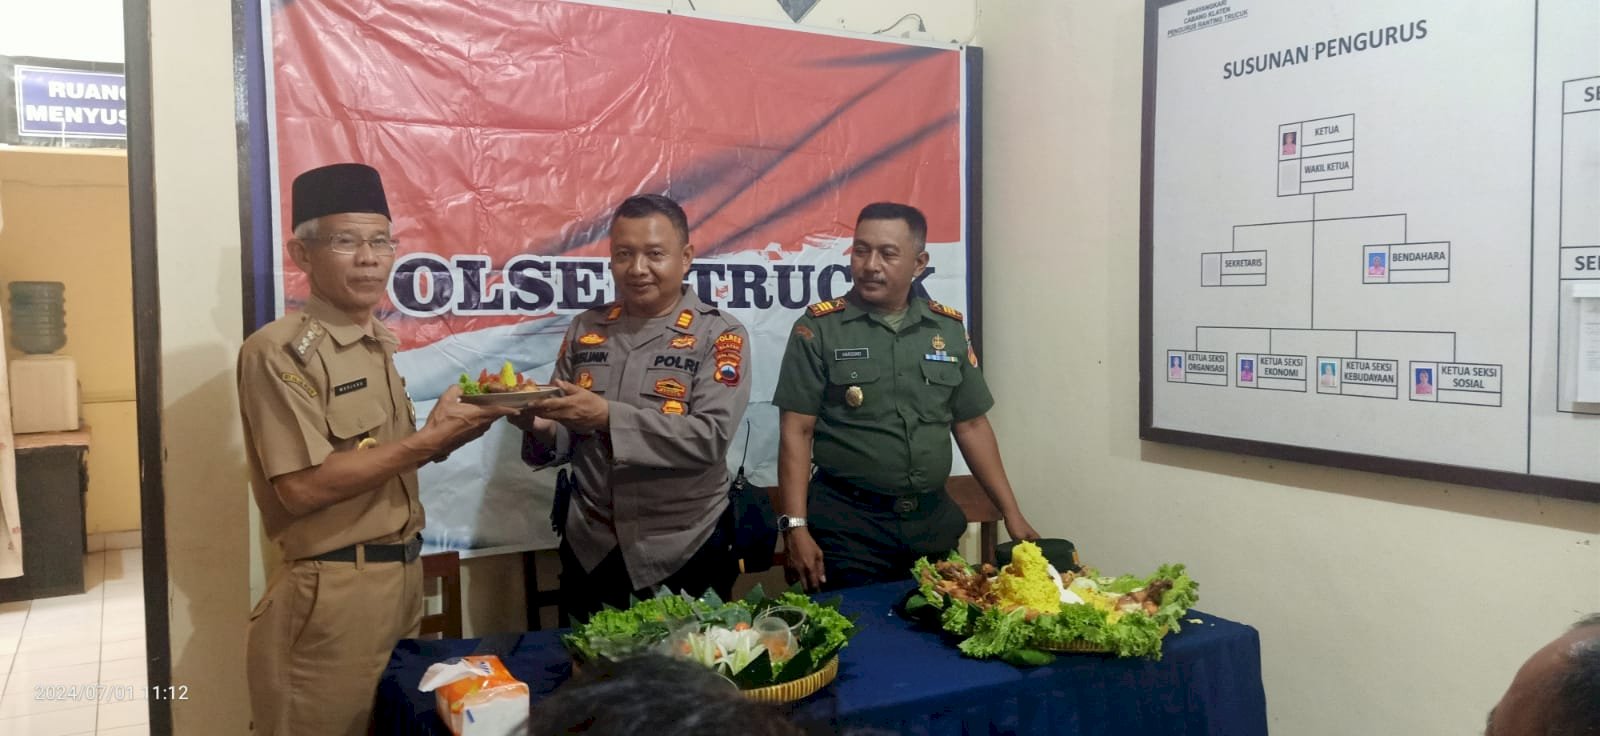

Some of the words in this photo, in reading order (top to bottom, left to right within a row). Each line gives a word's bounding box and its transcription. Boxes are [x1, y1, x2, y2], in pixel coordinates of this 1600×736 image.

[1184, 12, 1207, 24] CABANG
[1208, 6, 1231, 18] KLATEN
[1225, 9, 1248, 20] TRUCUK
[1223, 45, 1309, 79] SUSUNAN
[1314, 19, 1427, 60] PENGURUS
[1314, 125, 1340, 136] KETUA
[1304, 163, 1325, 174] WAKIL
[1326, 161, 1350, 172] KETUA
[1392, 251, 1446, 262] BENDAHARA
[1224, 258, 1263, 268] SEKRETARIS
[1574, 255, 1600, 271] SE
[392, 256, 617, 312] OLSE
[1188, 353, 1207, 362] KETUA
[1208, 354, 1225, 363] SEKSI
[1260, 357, 1282, 366] KETUA
[1284, 358, 1303, 367] SEKSI
[654, 355, 699, 374] POLRI
[1188, 363, 1225, 372] ORGANISASI
[1346, 361, 1370, 371] KETUA
[1372, 362, 1392, 372] SEKSI
[1264, 368, 1299, 377] EKONOMI
[1441, 366, 1470, 376] KETUA
[1472, 366, 1498, 377] SEKSI
[1344, 372, 1395, 383] KEBUDAYAAN
[1453, 378, 1485, 389] SOSIAL
